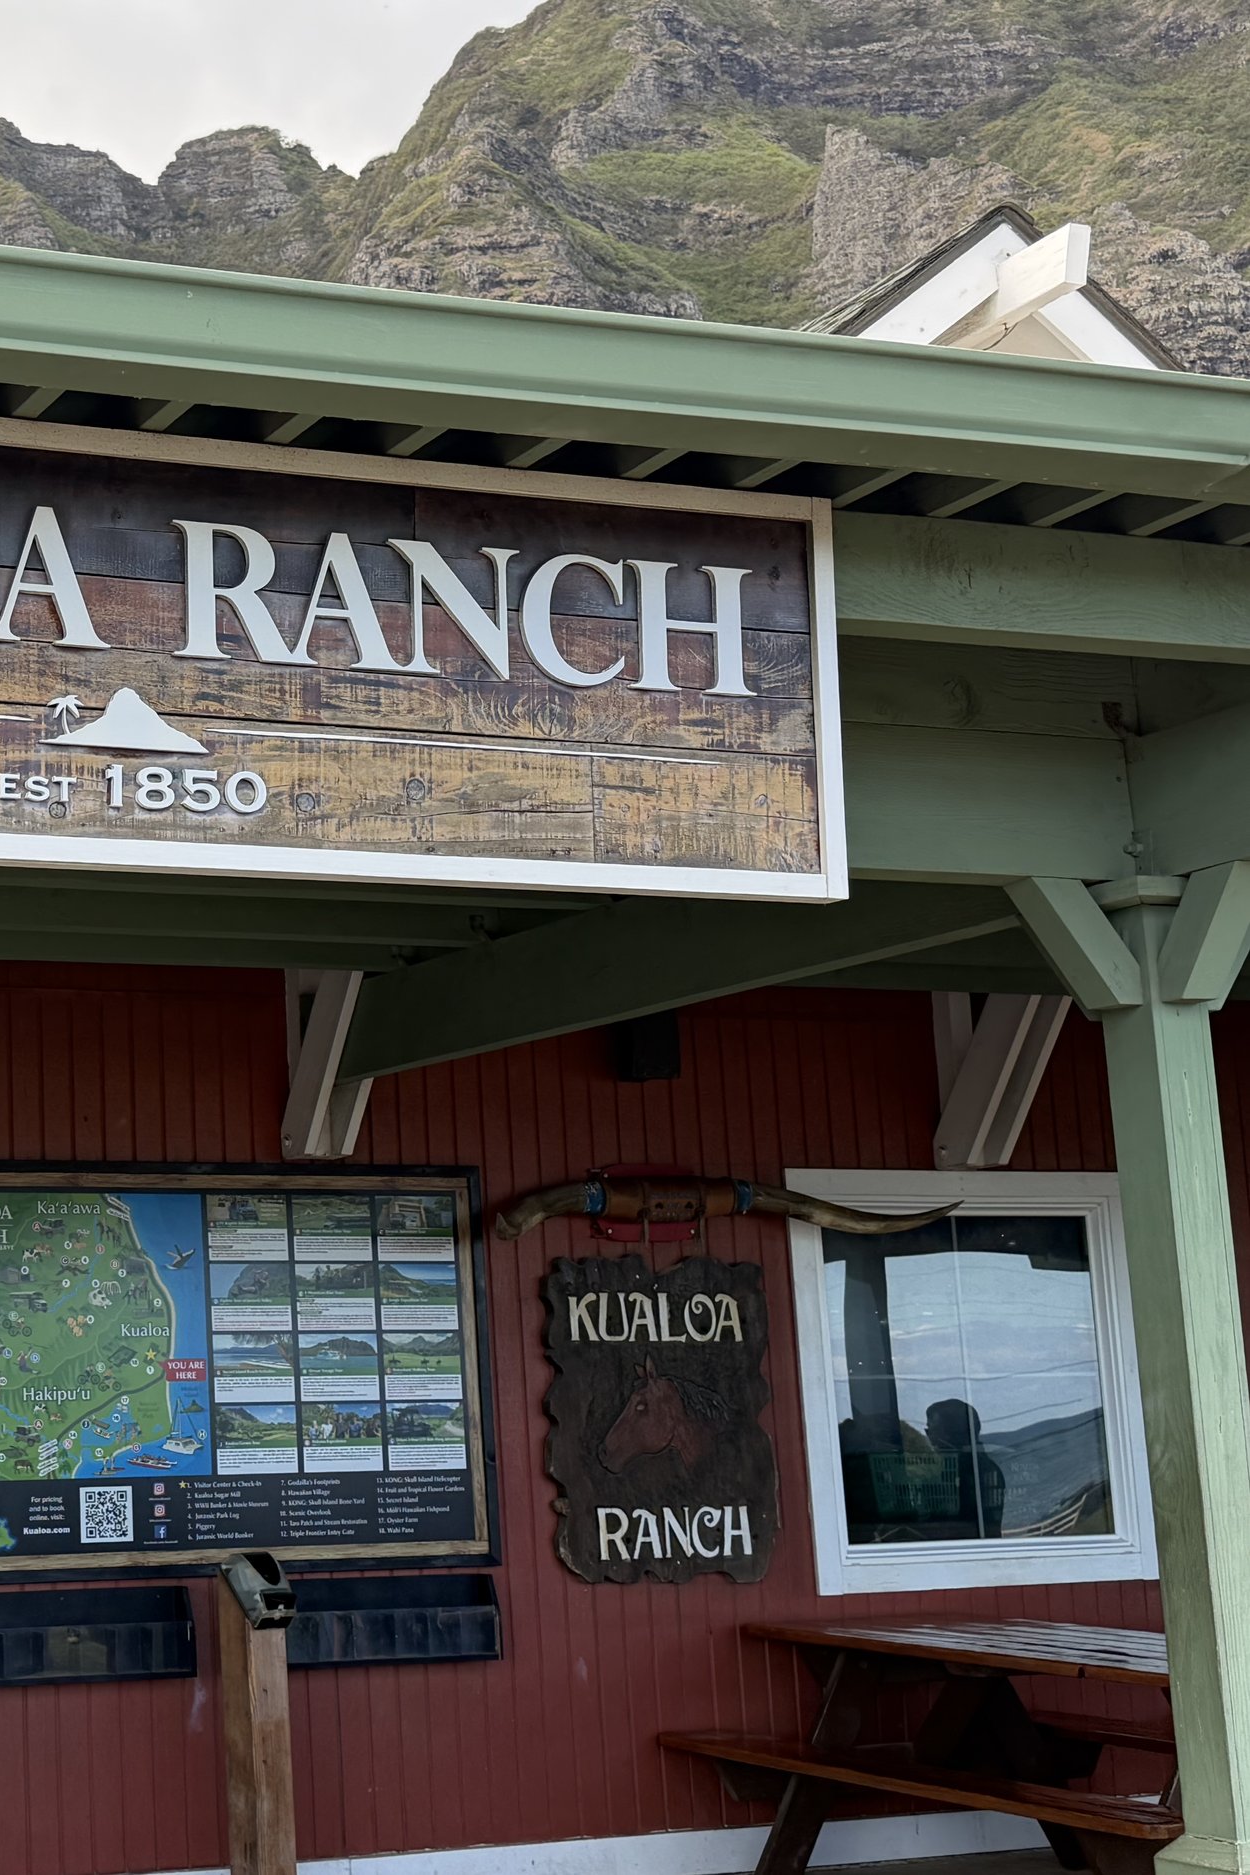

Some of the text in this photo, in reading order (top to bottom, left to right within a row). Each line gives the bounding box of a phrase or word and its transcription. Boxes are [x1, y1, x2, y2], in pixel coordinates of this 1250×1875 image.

[171, 518, 758, 698] RANCH
[104, 764, 267, 814] 1850
[121, 1323, 170, 1336] Kualoa
[568, 1292, 743, 1343] KUALOA
[408, 1486, 427, 1494] Tropical
[23, 1527, 70, 1535] Kualoa.com
[597, 1505, 753, 1561] RANCH
